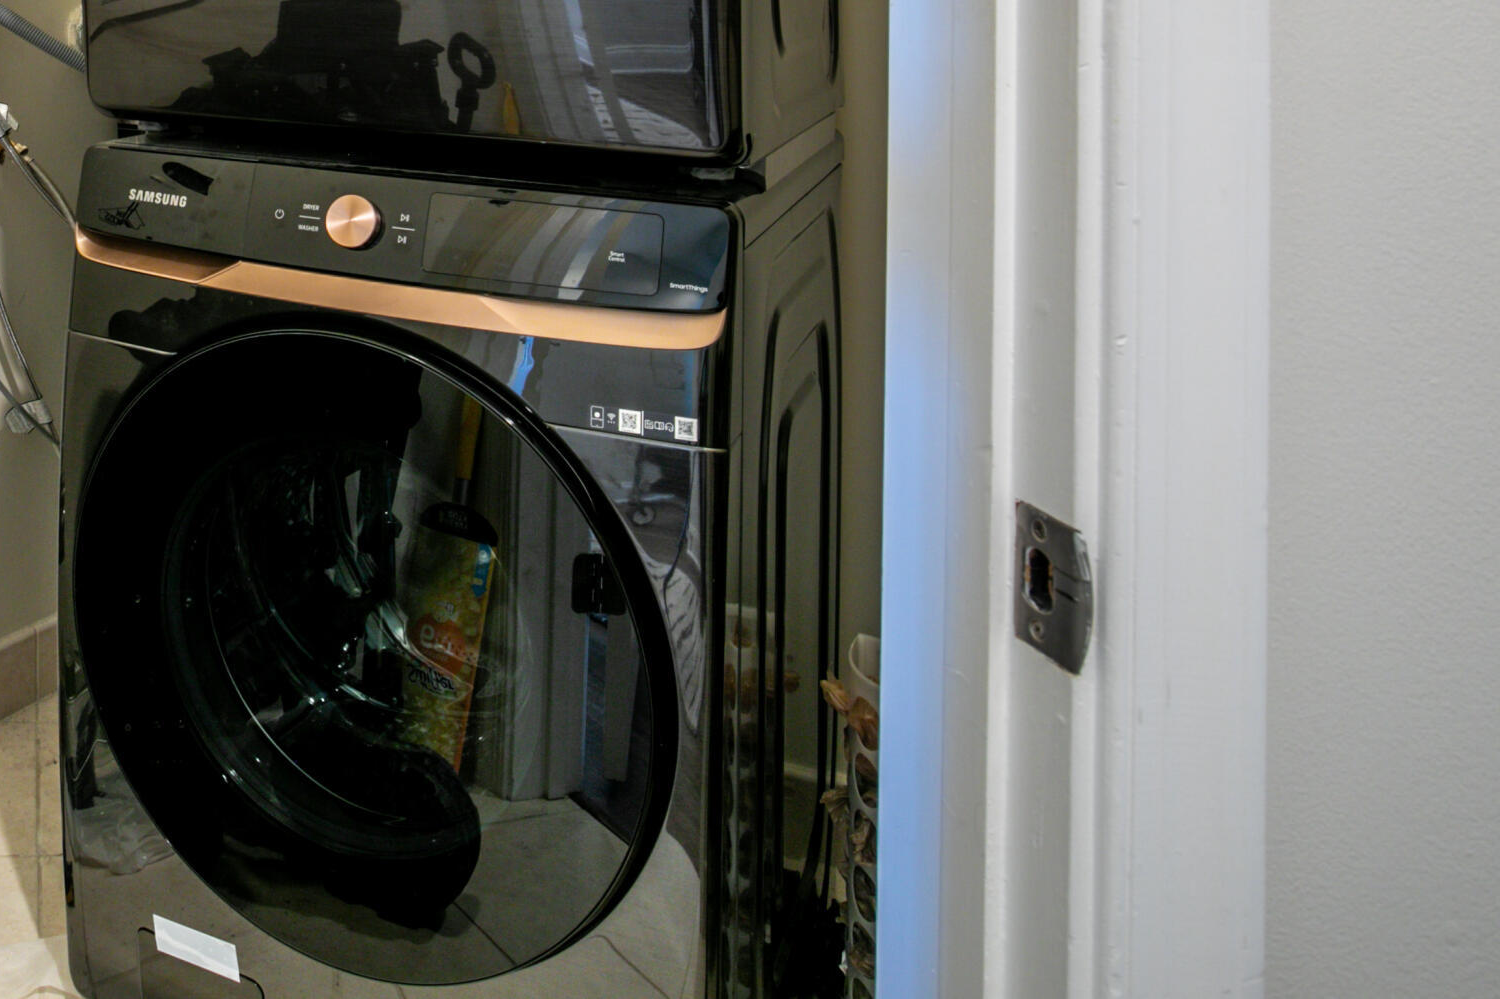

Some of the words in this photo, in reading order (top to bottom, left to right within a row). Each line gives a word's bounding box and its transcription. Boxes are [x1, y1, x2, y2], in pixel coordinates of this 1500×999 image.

[128, 188, 188, 208] SAMSUNG
[303, 203, 320, 211] DRYER
[298, 224, 319, 232] WASHER
[669, 282, 708, 293] SmartThings
